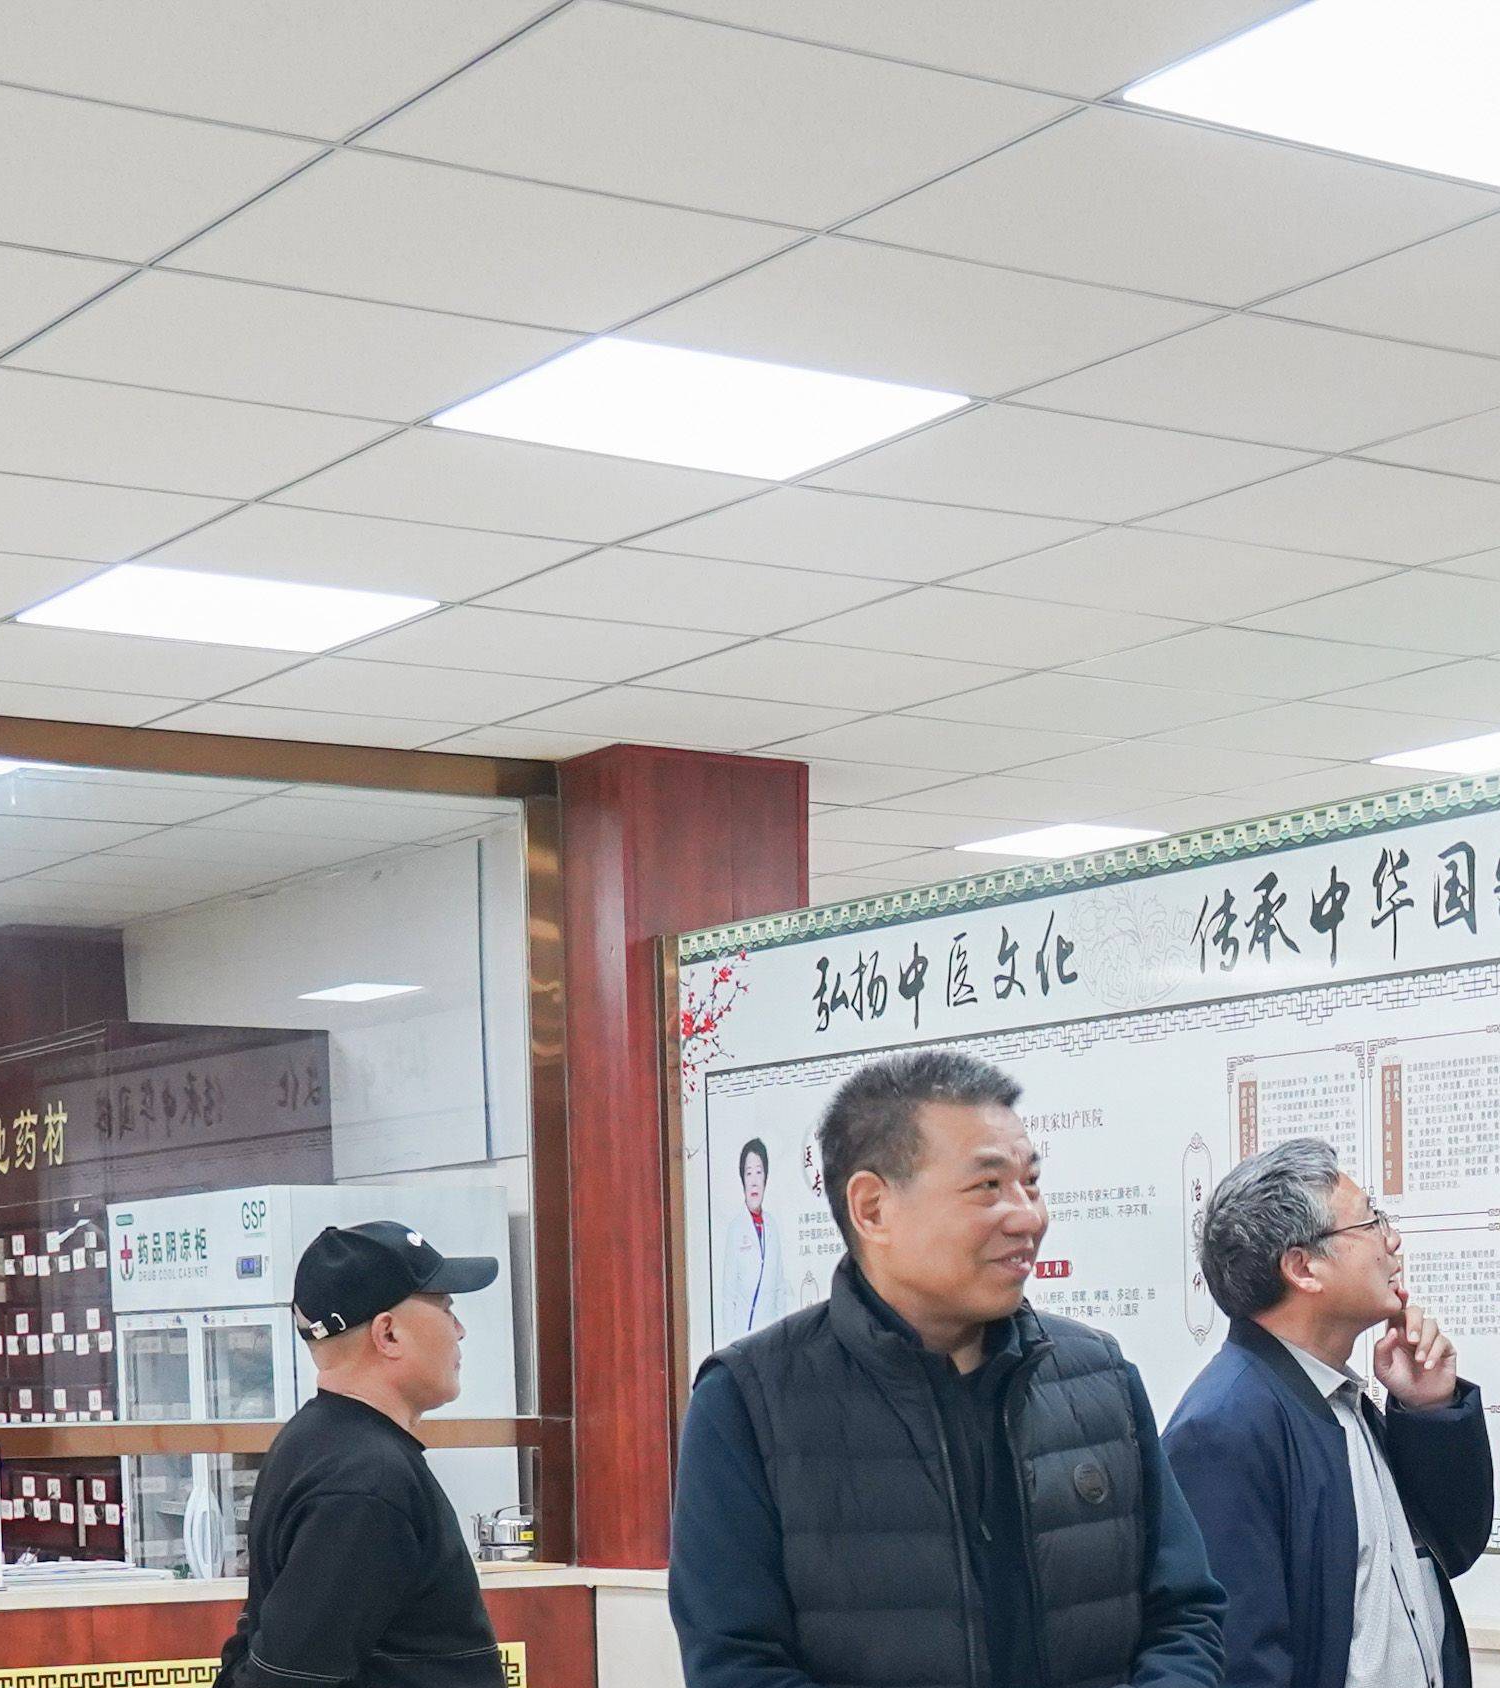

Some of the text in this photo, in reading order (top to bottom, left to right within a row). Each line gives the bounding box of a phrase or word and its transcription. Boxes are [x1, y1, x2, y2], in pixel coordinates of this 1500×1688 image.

[811, 909, 1080, 1034] 弘扬中医文化
[242, 1200, 266, 1230] GSP
[137, 1228, 207, 1265] 药品阴凉柜
